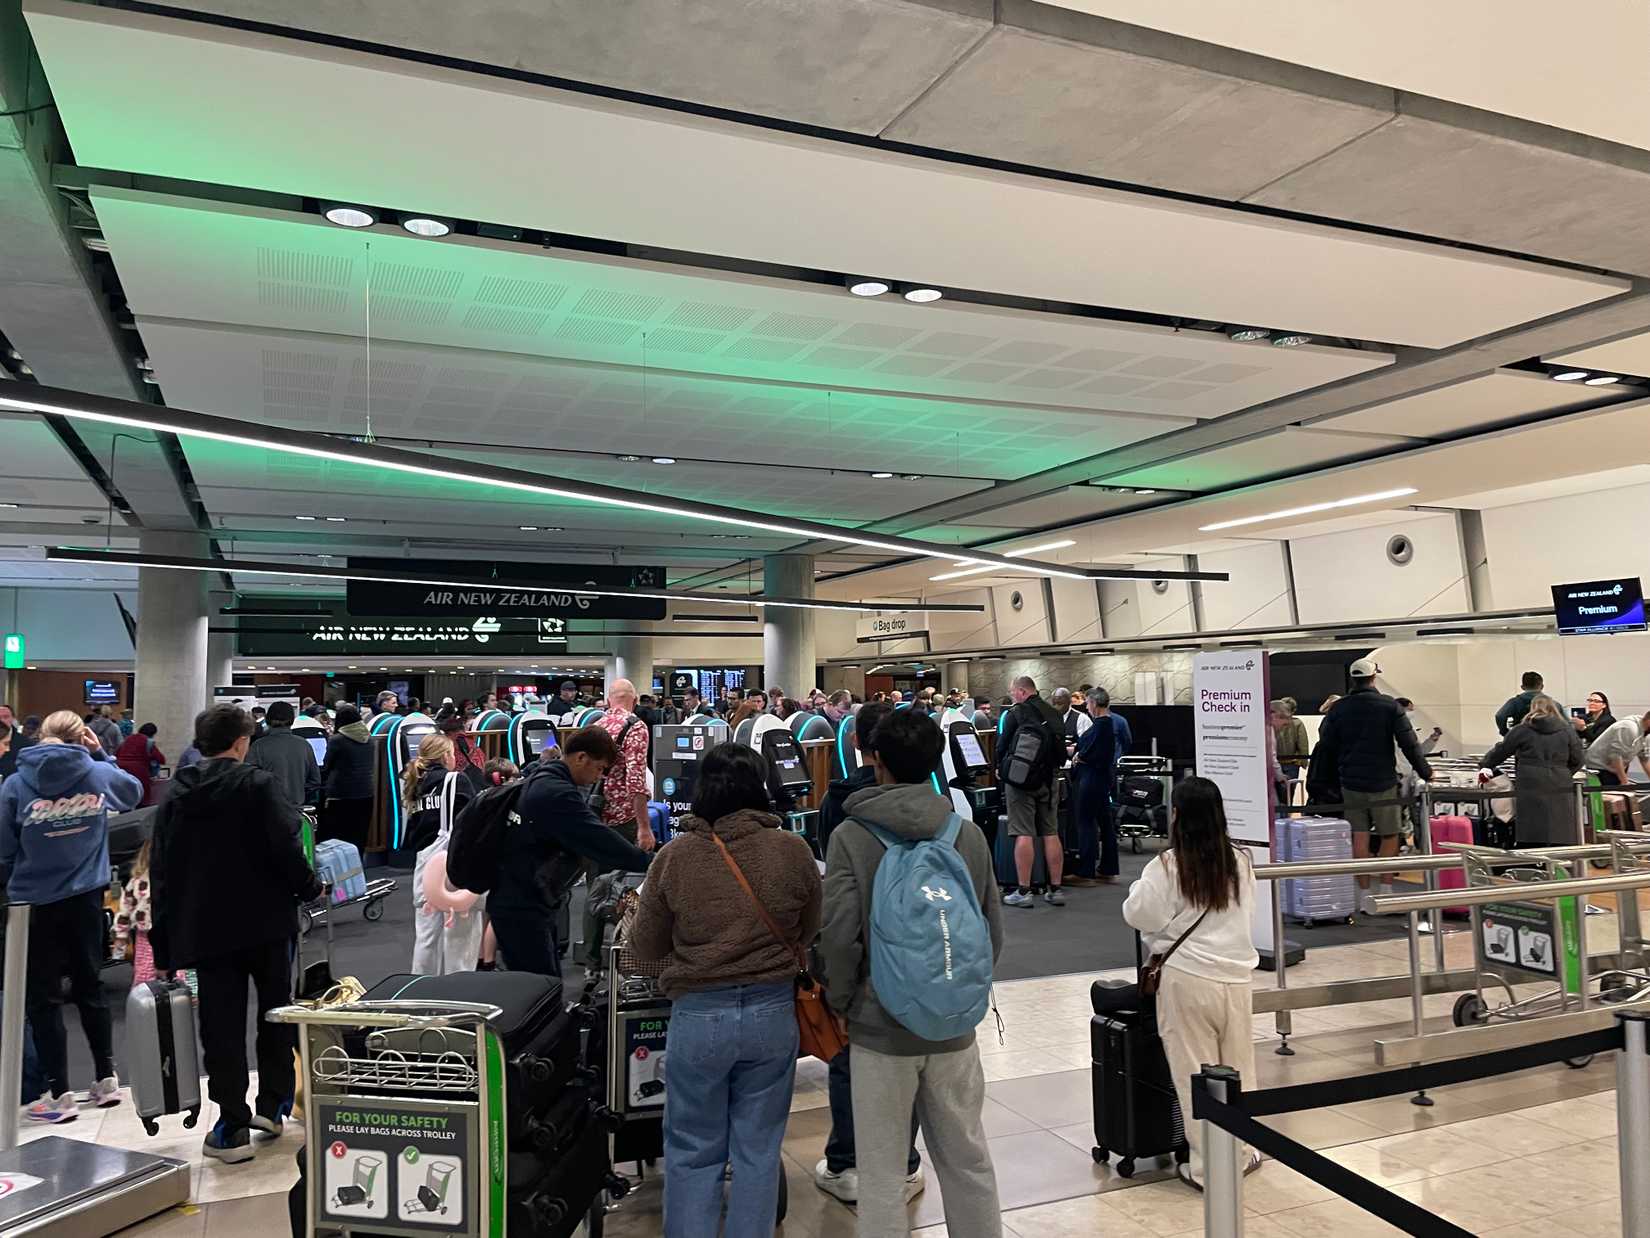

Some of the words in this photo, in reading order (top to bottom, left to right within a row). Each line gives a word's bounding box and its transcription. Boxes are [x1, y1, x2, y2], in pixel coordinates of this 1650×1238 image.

[424, 591, 453, 605] AIR
[457, 592, 496, 606] NEW
[498, 594, 572, 607] ZEALAND
[1590, 589, 1614, 597] ZEALAND
[1578, 605, 1618, 615] Premium
[878, 620, 890, 632] Bag
[891, 619, 905, 631] drop
[312, 625, 344, 641] AIR
[349, 625, 390, 641] NEW
[391, 625, 469, 641] ZEALAND
[1201, 689, 1251, 700] Premium
[1201, 701, 1237, 713] Check
[1240, 701, 1251, 713] in
[426, 794, 440, 810] CLU
[669, 816, 680, 827] ag
[939, 909, 950, 940] UNDER
[944, 940, 953, 980] ARMOUR
[640, 1020, 663, 1031] FOR
[633, 1031, 657, 1040] PLEASE
[336, 1111, 360, 1124] FOR
[362, 1113, 399, 1126] YOUR
[400, 1115, 449, 1129] SAFETY
[328, 1124, 354, 1134] PLEASE
[355, 1126, 369, 1134] LAY
[370, 1127, 390, 1136] BAGS
[391, 1129, 421, 1138] ACROSS
[422, 1130, 456, 1140] TROLLEY
